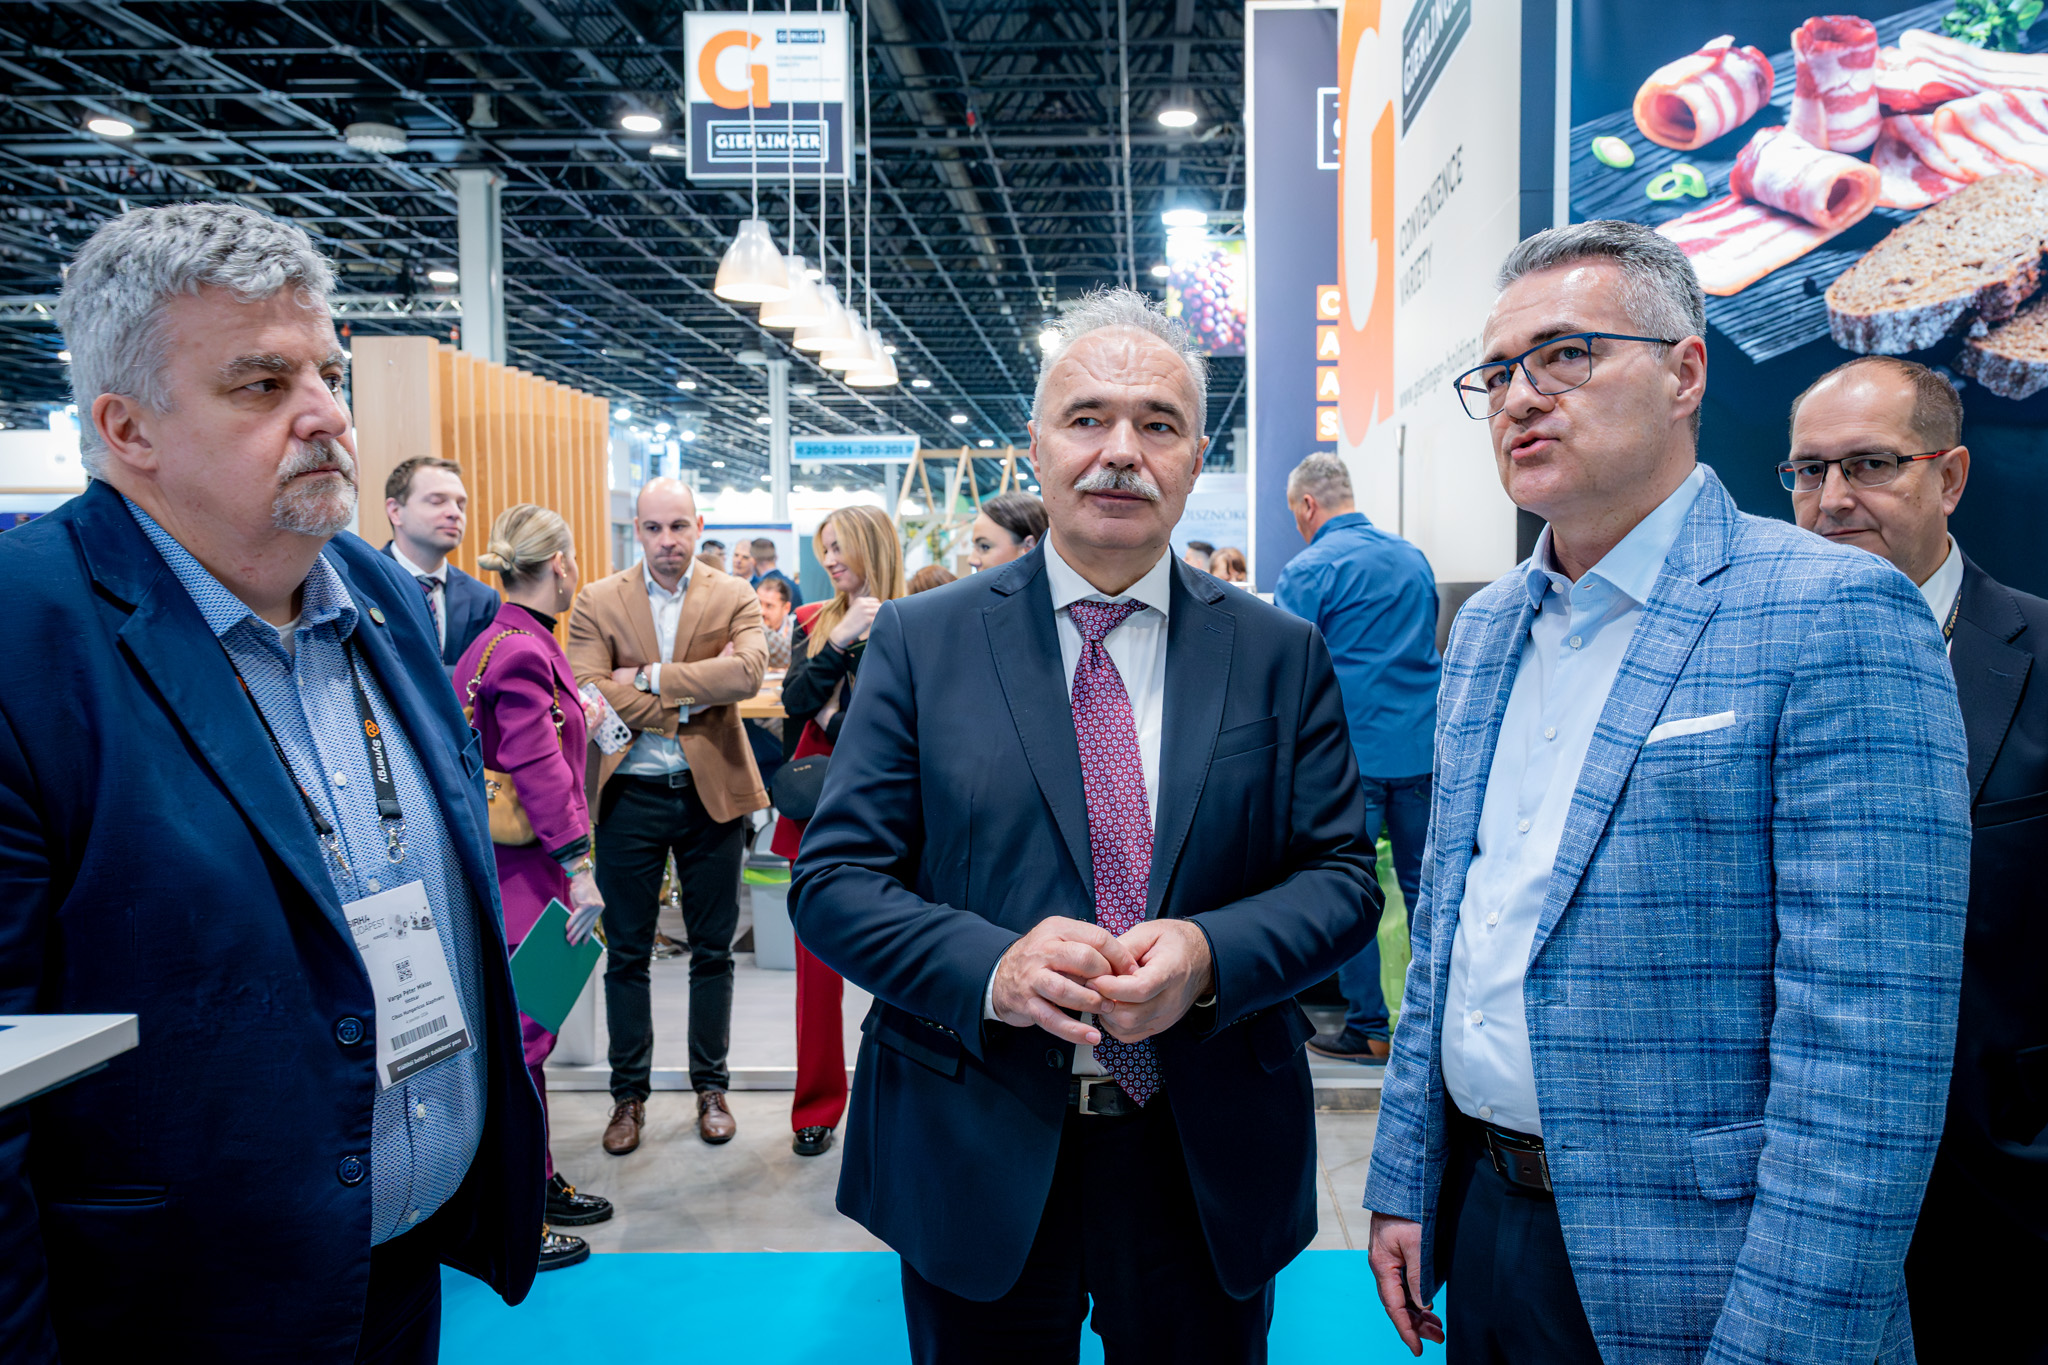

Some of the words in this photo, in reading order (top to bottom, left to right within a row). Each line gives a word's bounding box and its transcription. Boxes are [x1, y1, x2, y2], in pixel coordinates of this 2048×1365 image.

[1403, 0, 1459, 96] GIERLING
[1400, 144, 1463, 257] CONVENIENCE
[1400, 241, 1433, 307] VARIETY
